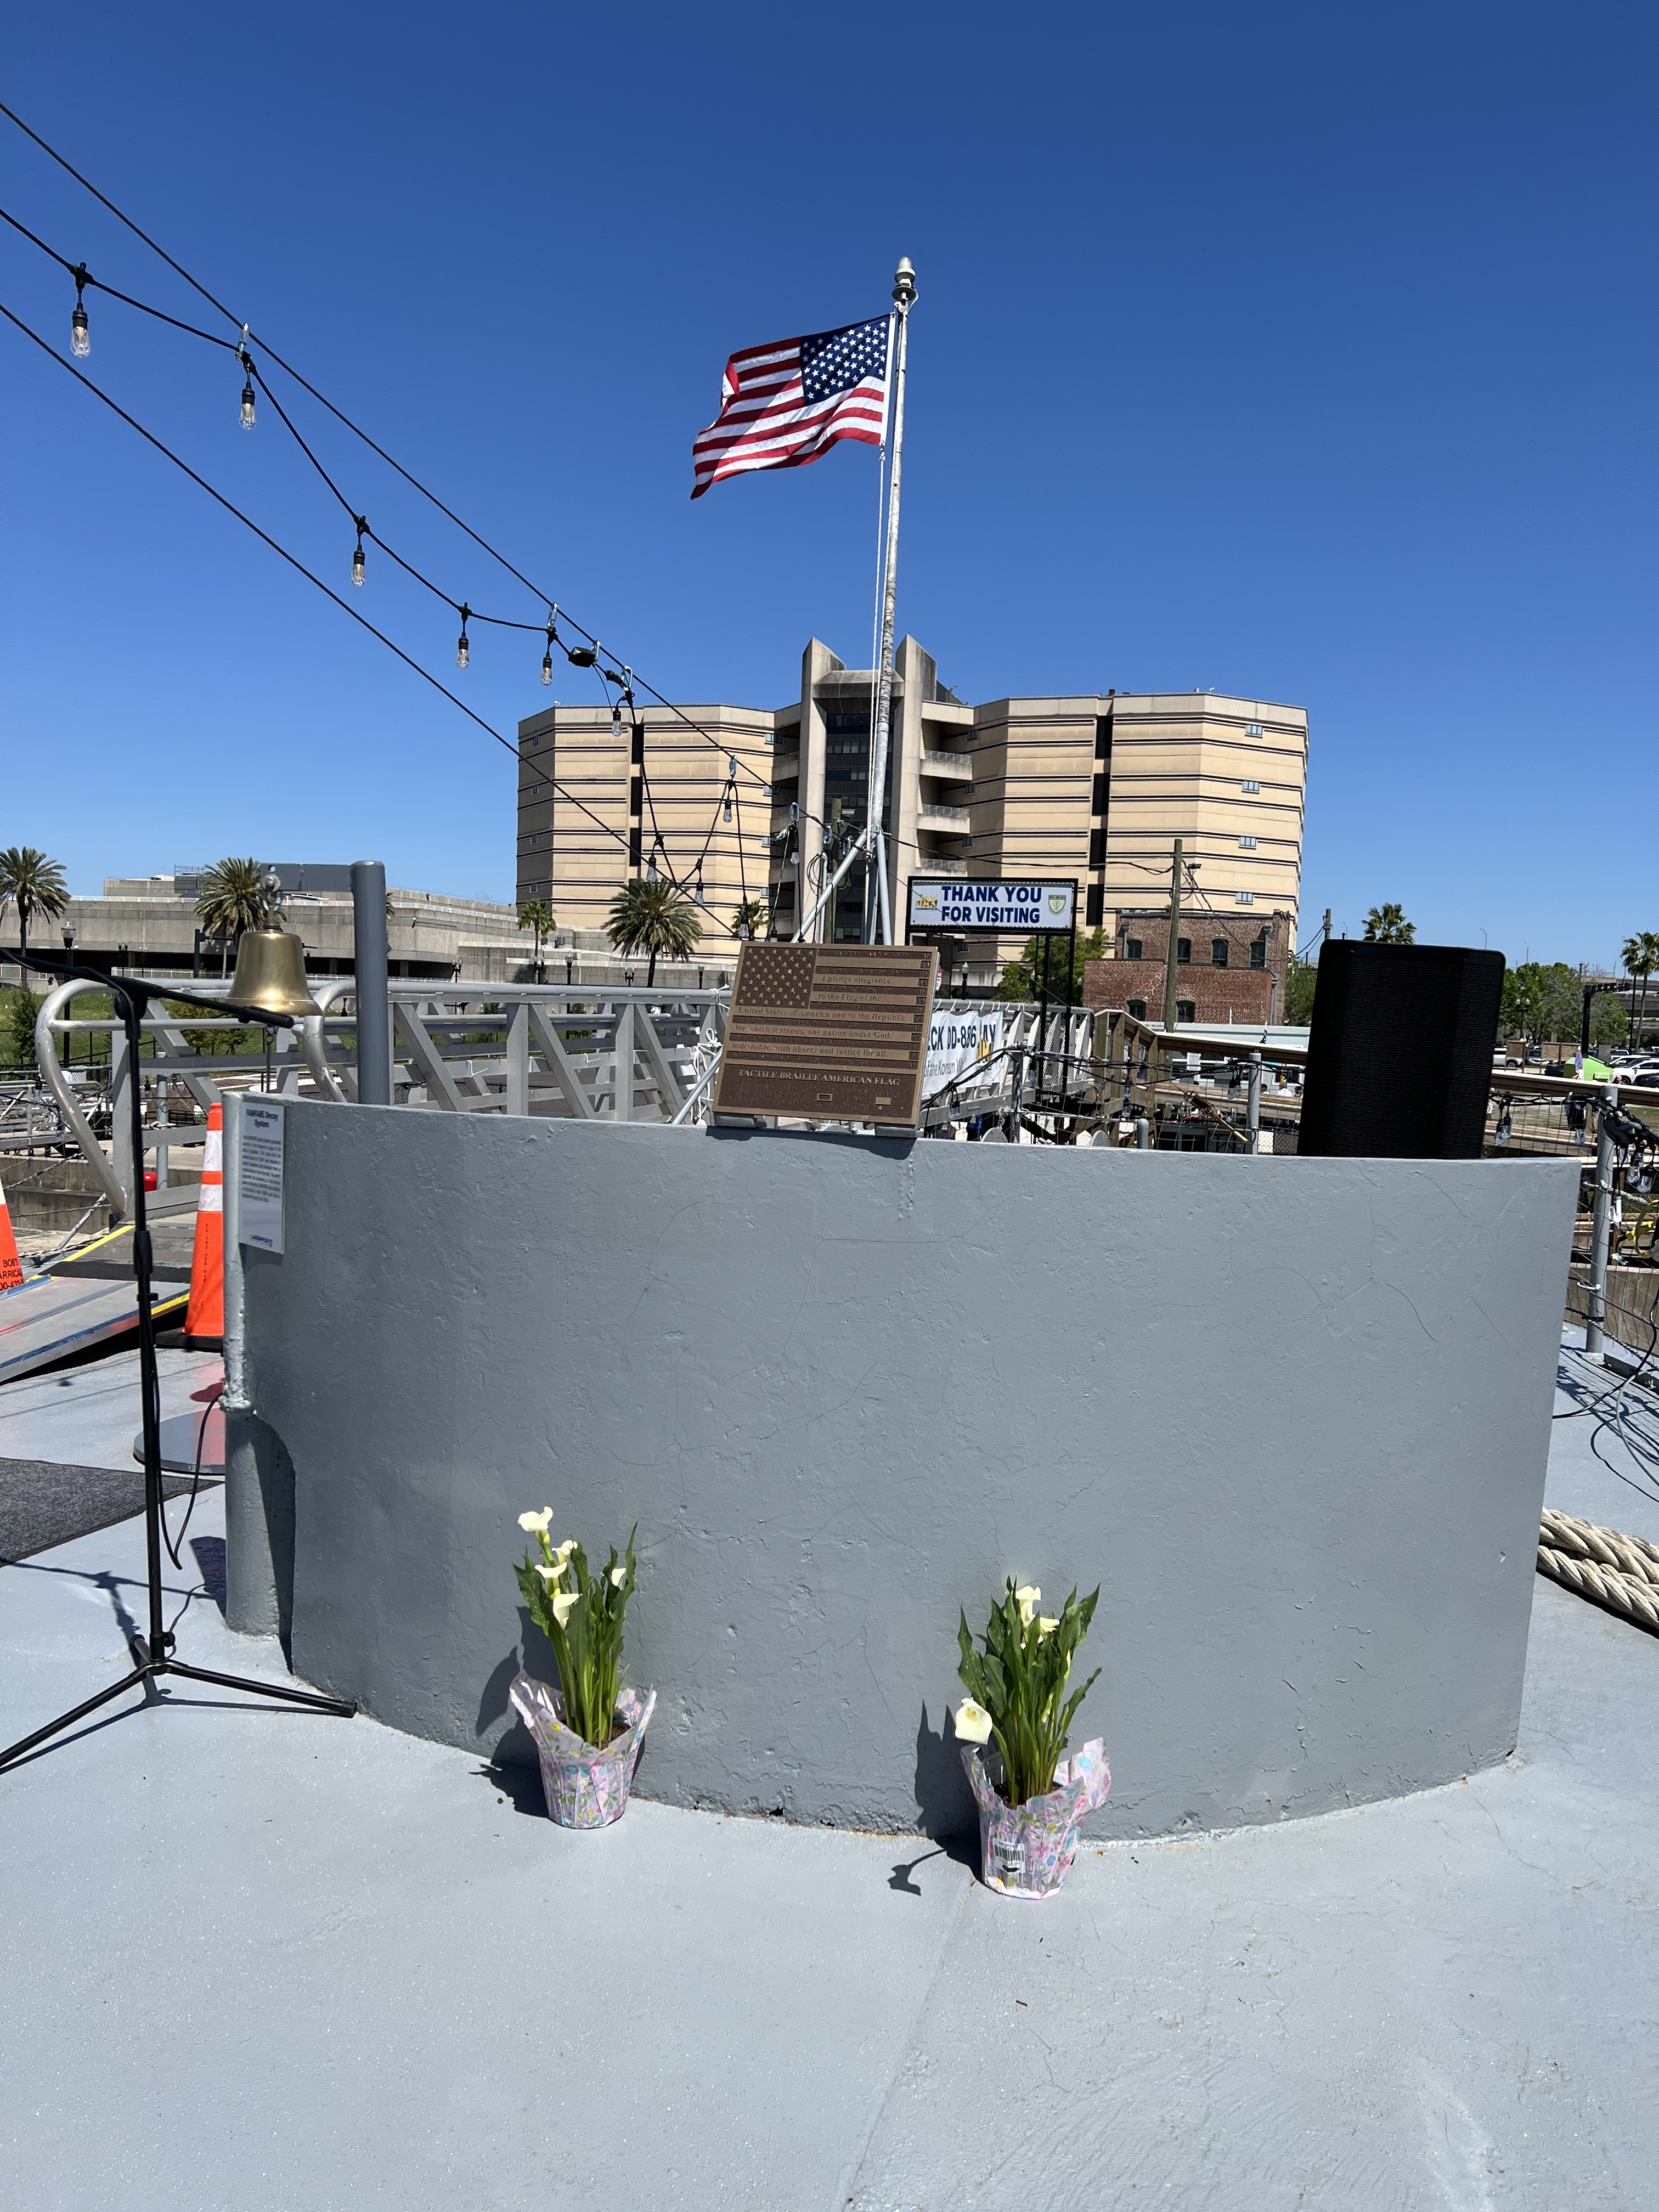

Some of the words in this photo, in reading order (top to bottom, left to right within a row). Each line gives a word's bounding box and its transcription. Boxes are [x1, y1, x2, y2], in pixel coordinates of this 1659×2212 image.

[941, 886, 999, 902] THANK
[1005, 887, 1042, 903] YOU
[941, 906, 972, 922] FOR
[976, 906, 1040, 923] VISITING
[842, 994, 857, 1002] Flag
[872, 1013, 905, 1022] Republic
[793, 1046, 817, 1055] liberty
[738, 1069, 778, 1079] TACTILE
[779, 1071, 821, 1082] BRAILLE
[821, 1074, 873, 1085] AMERICAN
[874, 1077, 900, 1086] FLAG
